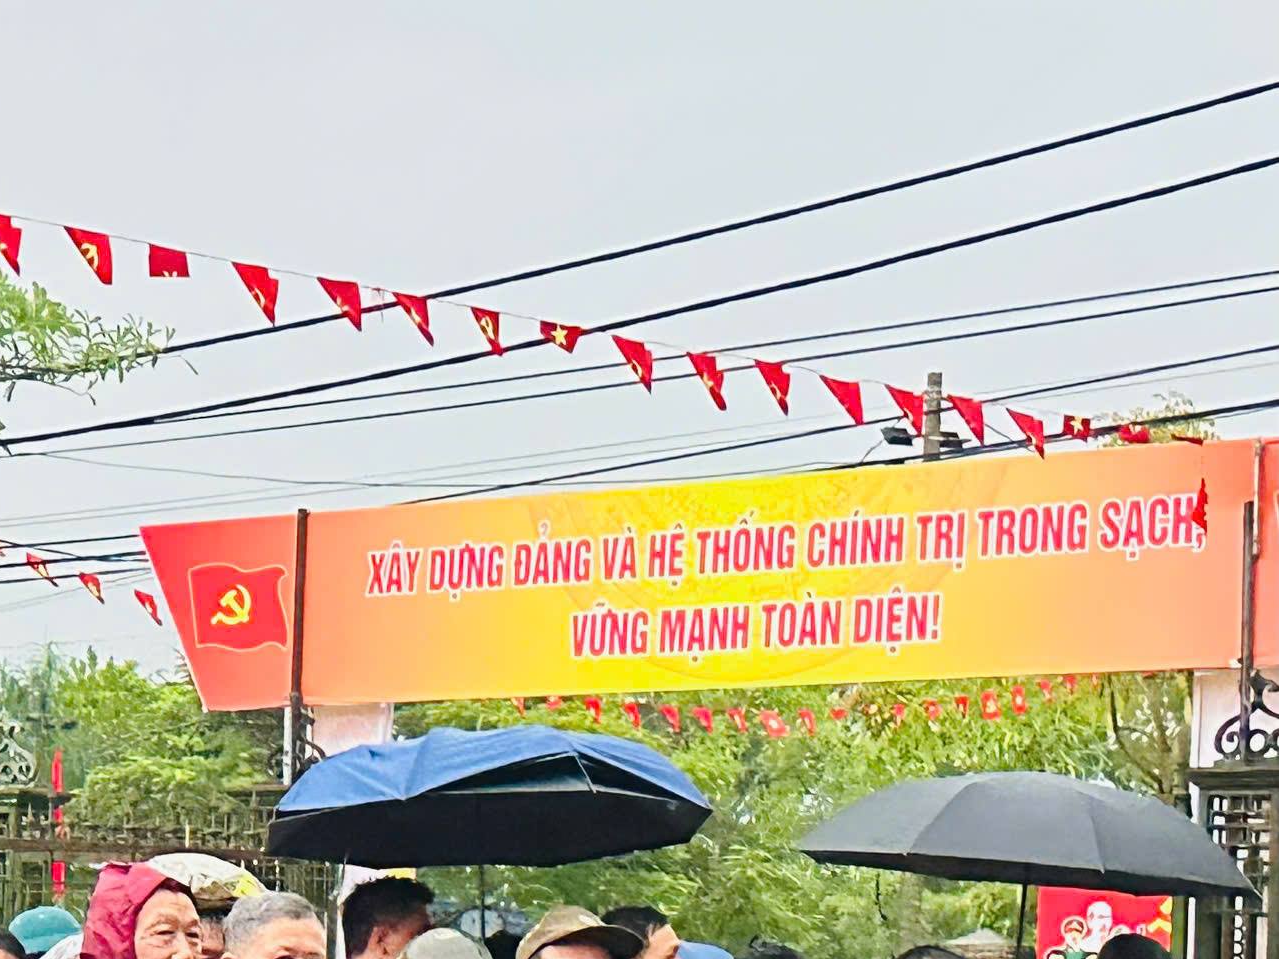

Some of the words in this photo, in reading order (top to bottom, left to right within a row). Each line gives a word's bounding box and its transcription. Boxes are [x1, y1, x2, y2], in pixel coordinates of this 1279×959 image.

[368, 541, 420, 595] XÂY
[429, 543, 504, 599] DỰNG
[514, 523, 591, 586] ĐẢNG
[602, 527, 637, 580] VÀ
[648, 523, 683, 586] HỆ
[696, 511, 795, 575] THỐNG
[807, 509, 904, 566] CHÍNH
[918, 512, 965, 569] TRỊ
[978, 503, 1087, 556] TRONG
[572, 602, 648, 657] VỮNG
[659, 605, 750, 663] MẠNH
[762, 591, 842, 648] TOÀN
[853, 587, 940, 653] DIỆN!
